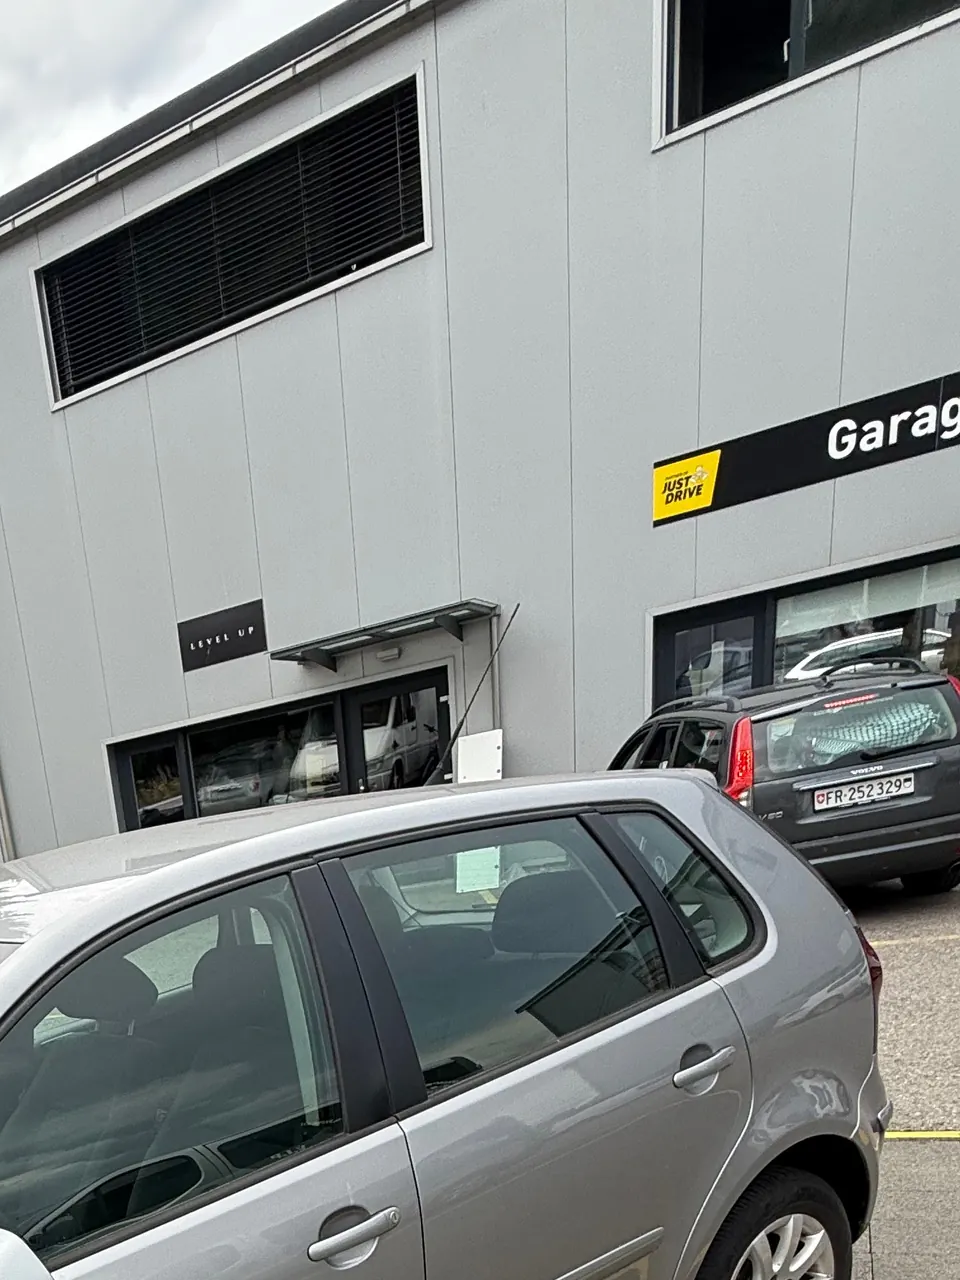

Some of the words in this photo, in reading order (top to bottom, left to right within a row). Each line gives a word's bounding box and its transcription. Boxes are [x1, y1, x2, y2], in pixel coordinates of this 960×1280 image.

[662, 475, 692, 494] JUST
[665, 484, 703, 505] DRIVE
[190, 633, 229, 650] LEVEL
[238, 626, 254, 637] UP
[850, 765, 884, 775] VOLVO
